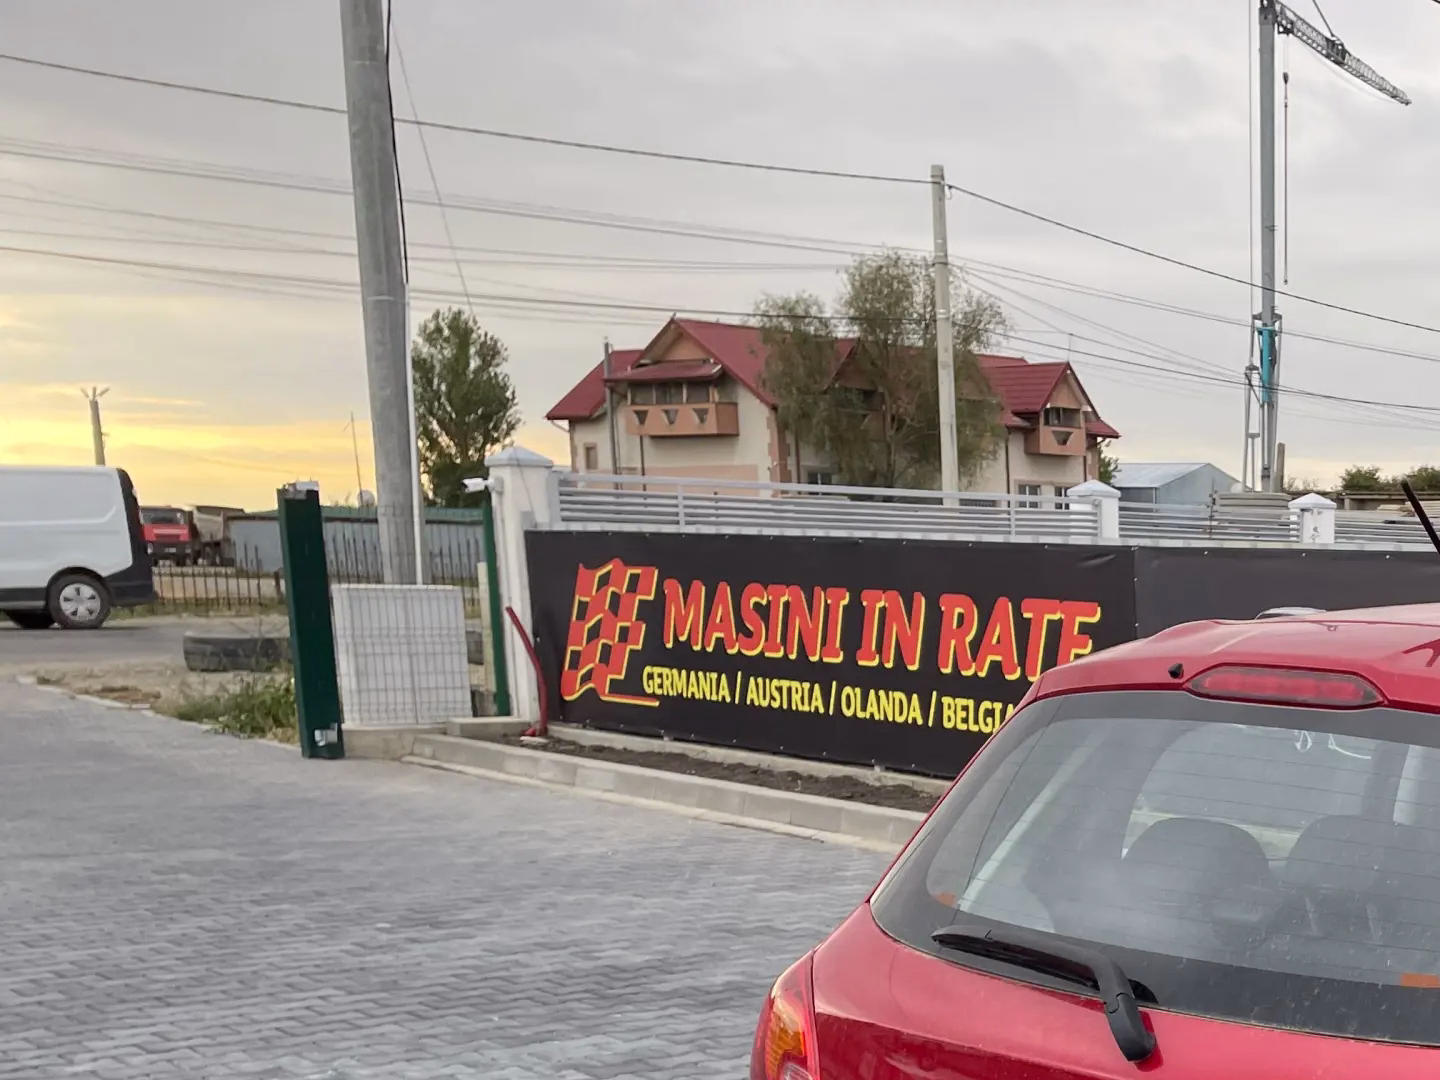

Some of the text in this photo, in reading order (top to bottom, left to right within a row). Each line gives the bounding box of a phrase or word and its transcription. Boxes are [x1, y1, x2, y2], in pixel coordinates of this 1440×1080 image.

[663, 578, 1101, 682] MASINI IN RATE
[642, 665, 731, 703] GERMANIA
[746, 676, 825, 714] AUSTRIA
[841, 686, 923, 726] OLANDA
[941, 696, 1013, 734] BELGI
